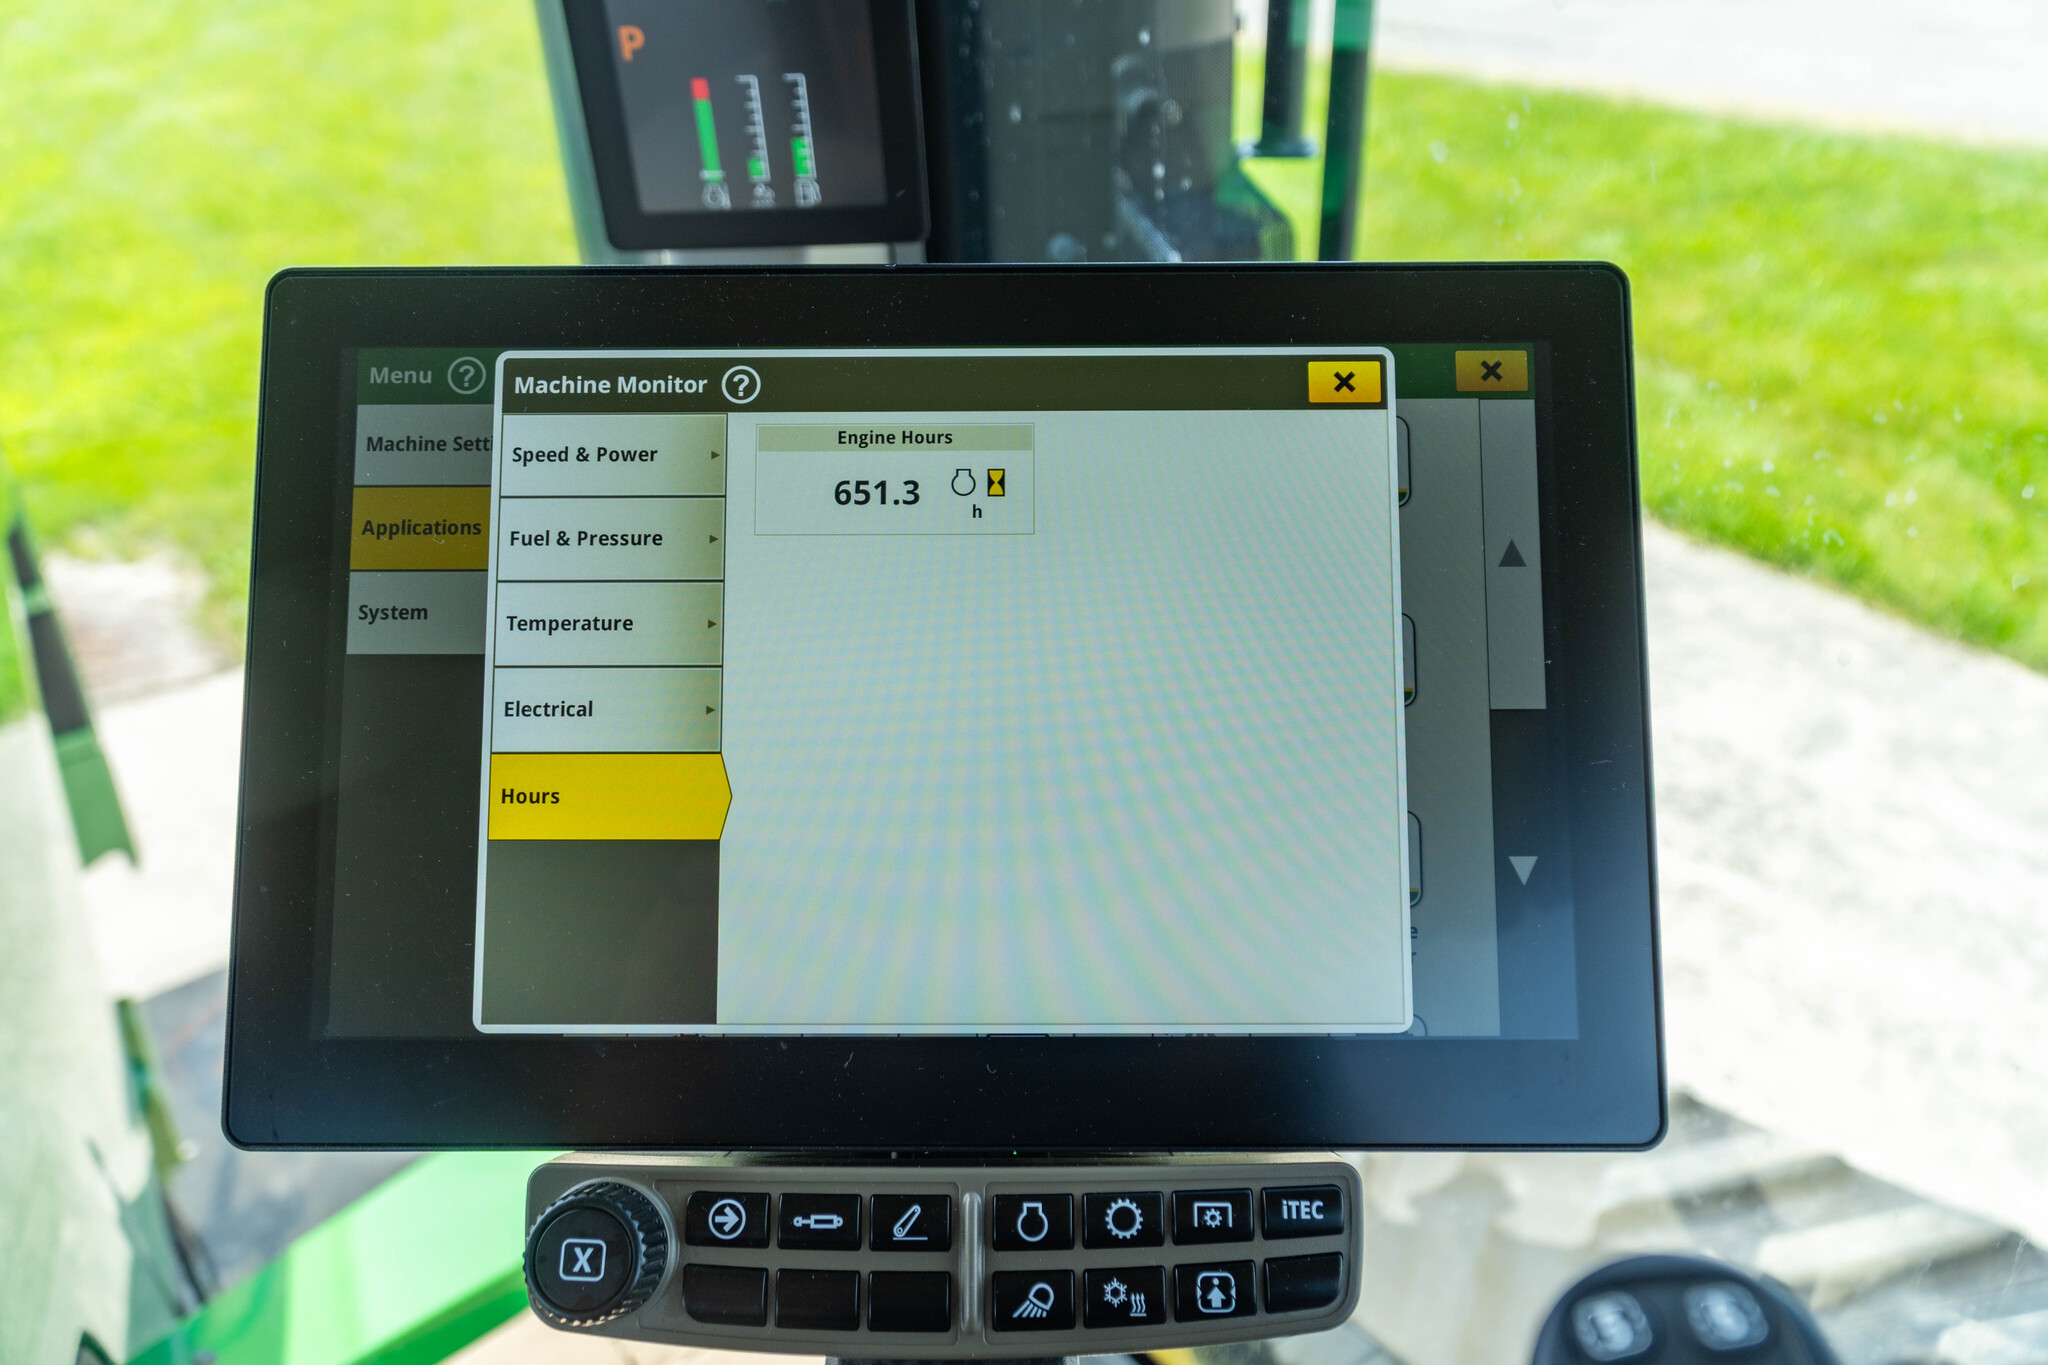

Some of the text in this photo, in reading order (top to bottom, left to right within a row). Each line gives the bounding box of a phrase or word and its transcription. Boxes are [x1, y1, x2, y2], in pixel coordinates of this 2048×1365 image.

[617, 24, 646, 62] P
[369, 366, 432, 384] Menu
[514, 374, 708, 394] Machine Monitor
[366, 435, 448, 452] Machine
[838, 429, 953, 449] Engine Hours
[512, 446, 658, 468] Speed & Power
[834, 479, 920, 506] 651.3
[972, 503, 983, 519] h
[361, 518, 482, 541] Applications
[510, 529, 663, 547] Fuel & Pressure
[358, 604, 428, 625] System
[506, 615, 634, 636] Temperature
[504, 700, 593, 718] Electrical
[501, 788, 560, 805] Hours
[1281, 1199, 1324, 1220] iTEC
